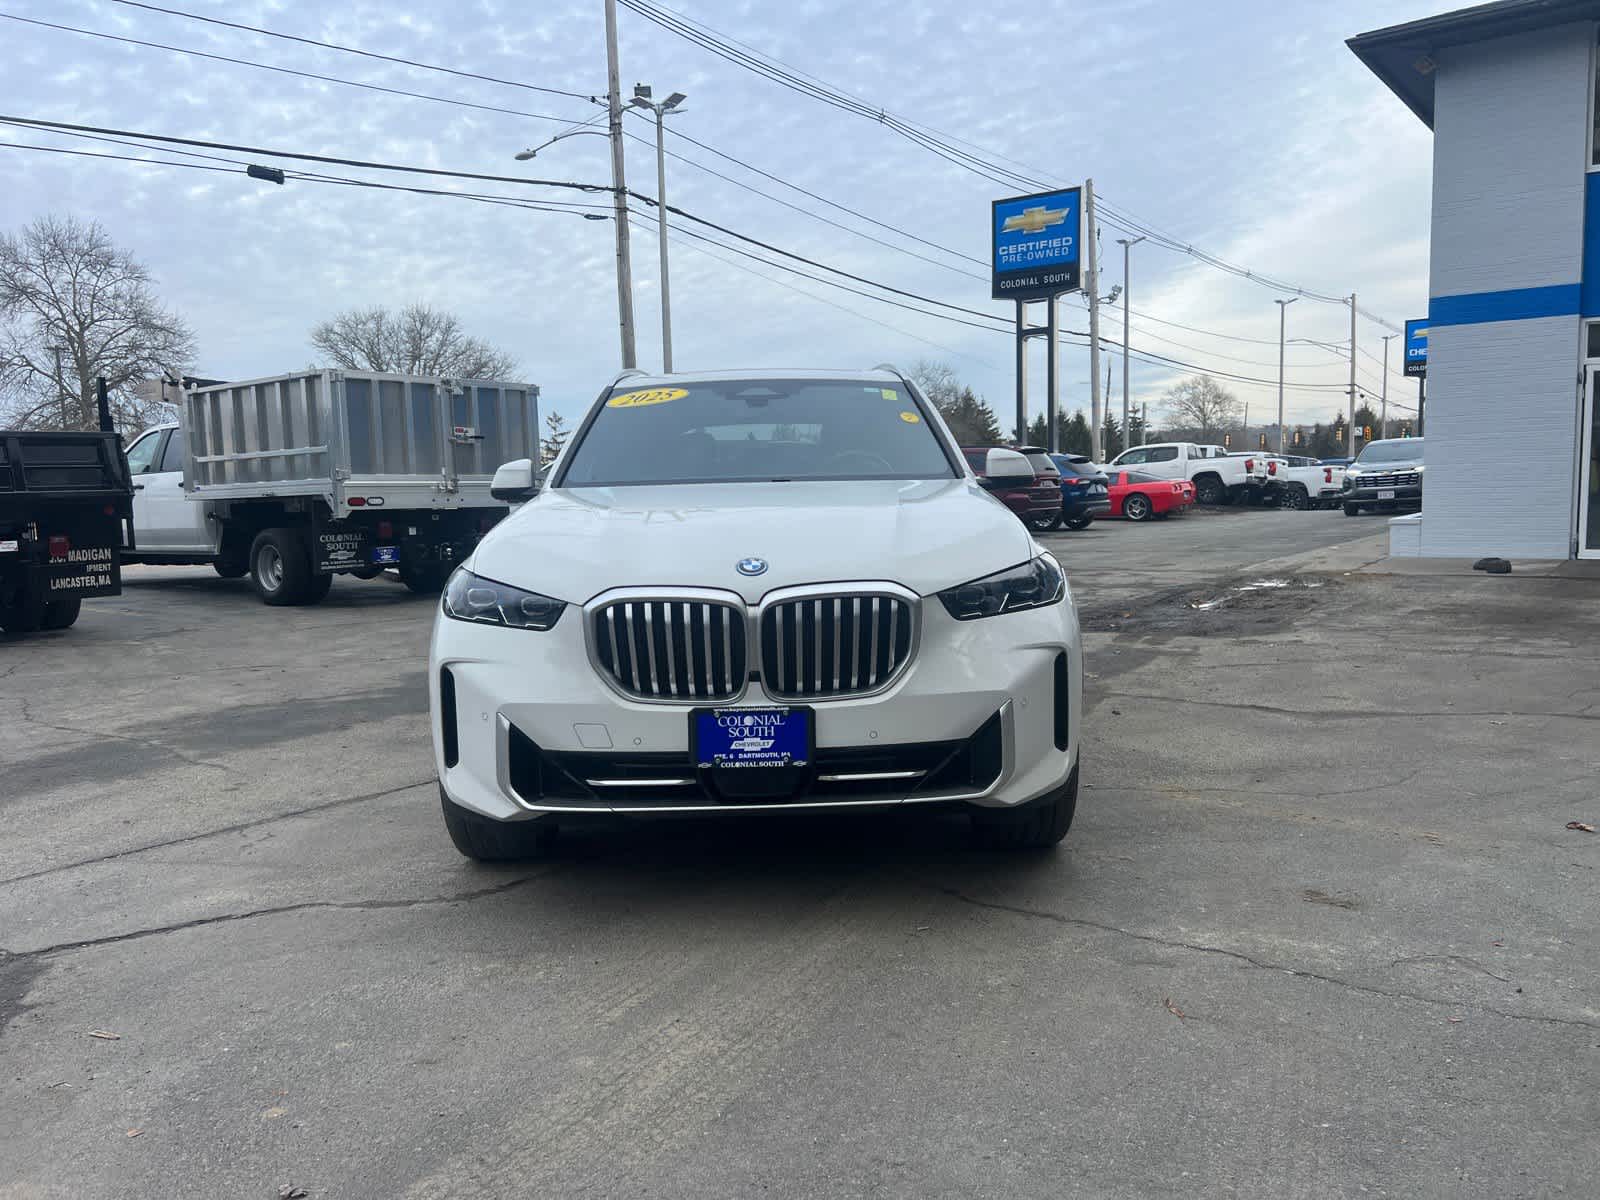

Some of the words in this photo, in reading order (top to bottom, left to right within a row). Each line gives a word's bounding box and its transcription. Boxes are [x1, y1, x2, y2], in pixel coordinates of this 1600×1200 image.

[999, 237, 1073, 255] CERTIFIED
[1002, 247, 1069, 263] PRE-OWNED
[1001, 277, 1039, 289] COLONIAL
[1044, 273, 1071, 284] SOUTH
[320, 534, 365, 543] COLONIAL
[326, 542, 358, 551] SOUTH
[68, 548, 112, 562] MADIGAN
[718, 715, 785, 727] COLONIAL
[728, 726, 775, 737] SOUTH
